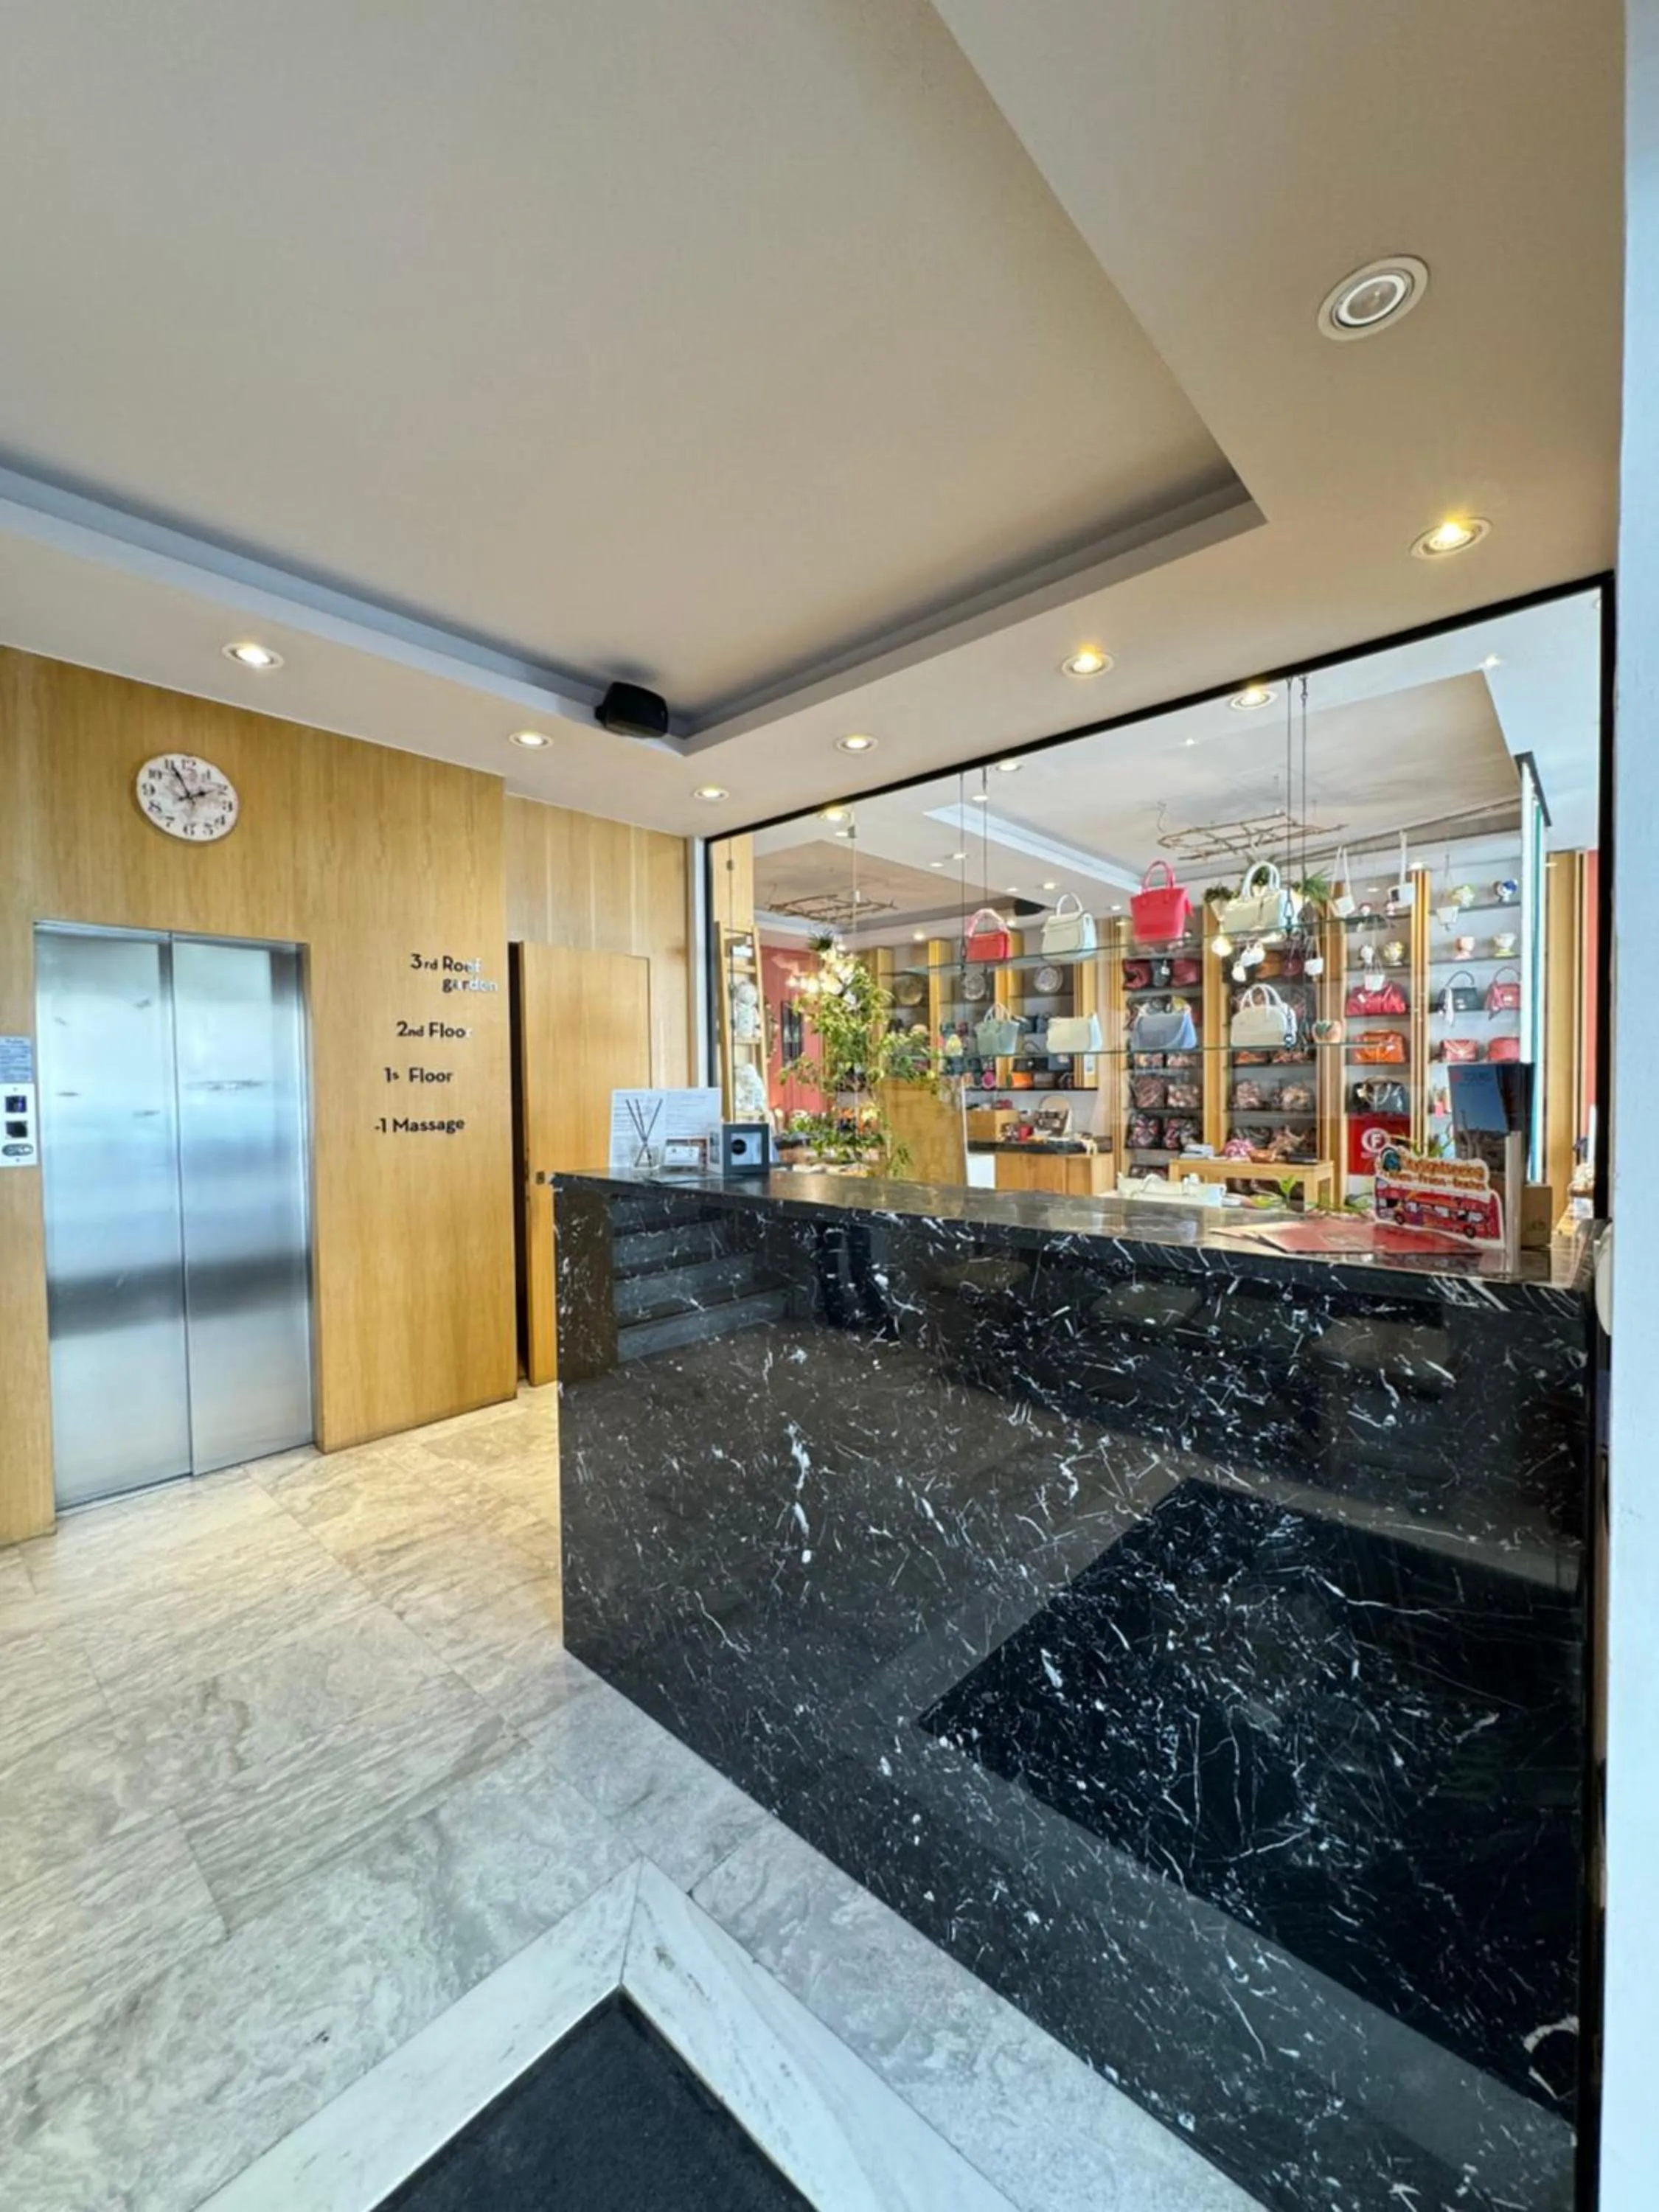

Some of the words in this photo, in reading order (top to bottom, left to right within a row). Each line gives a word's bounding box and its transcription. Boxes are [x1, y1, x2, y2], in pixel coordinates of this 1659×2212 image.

[410, 953, 438, 970] 3rd
[396, 1020, 424, 1037] 2nd
[409, 1067, 453, 1082] Floor
[392, 1118, 465, 1134] Massage
